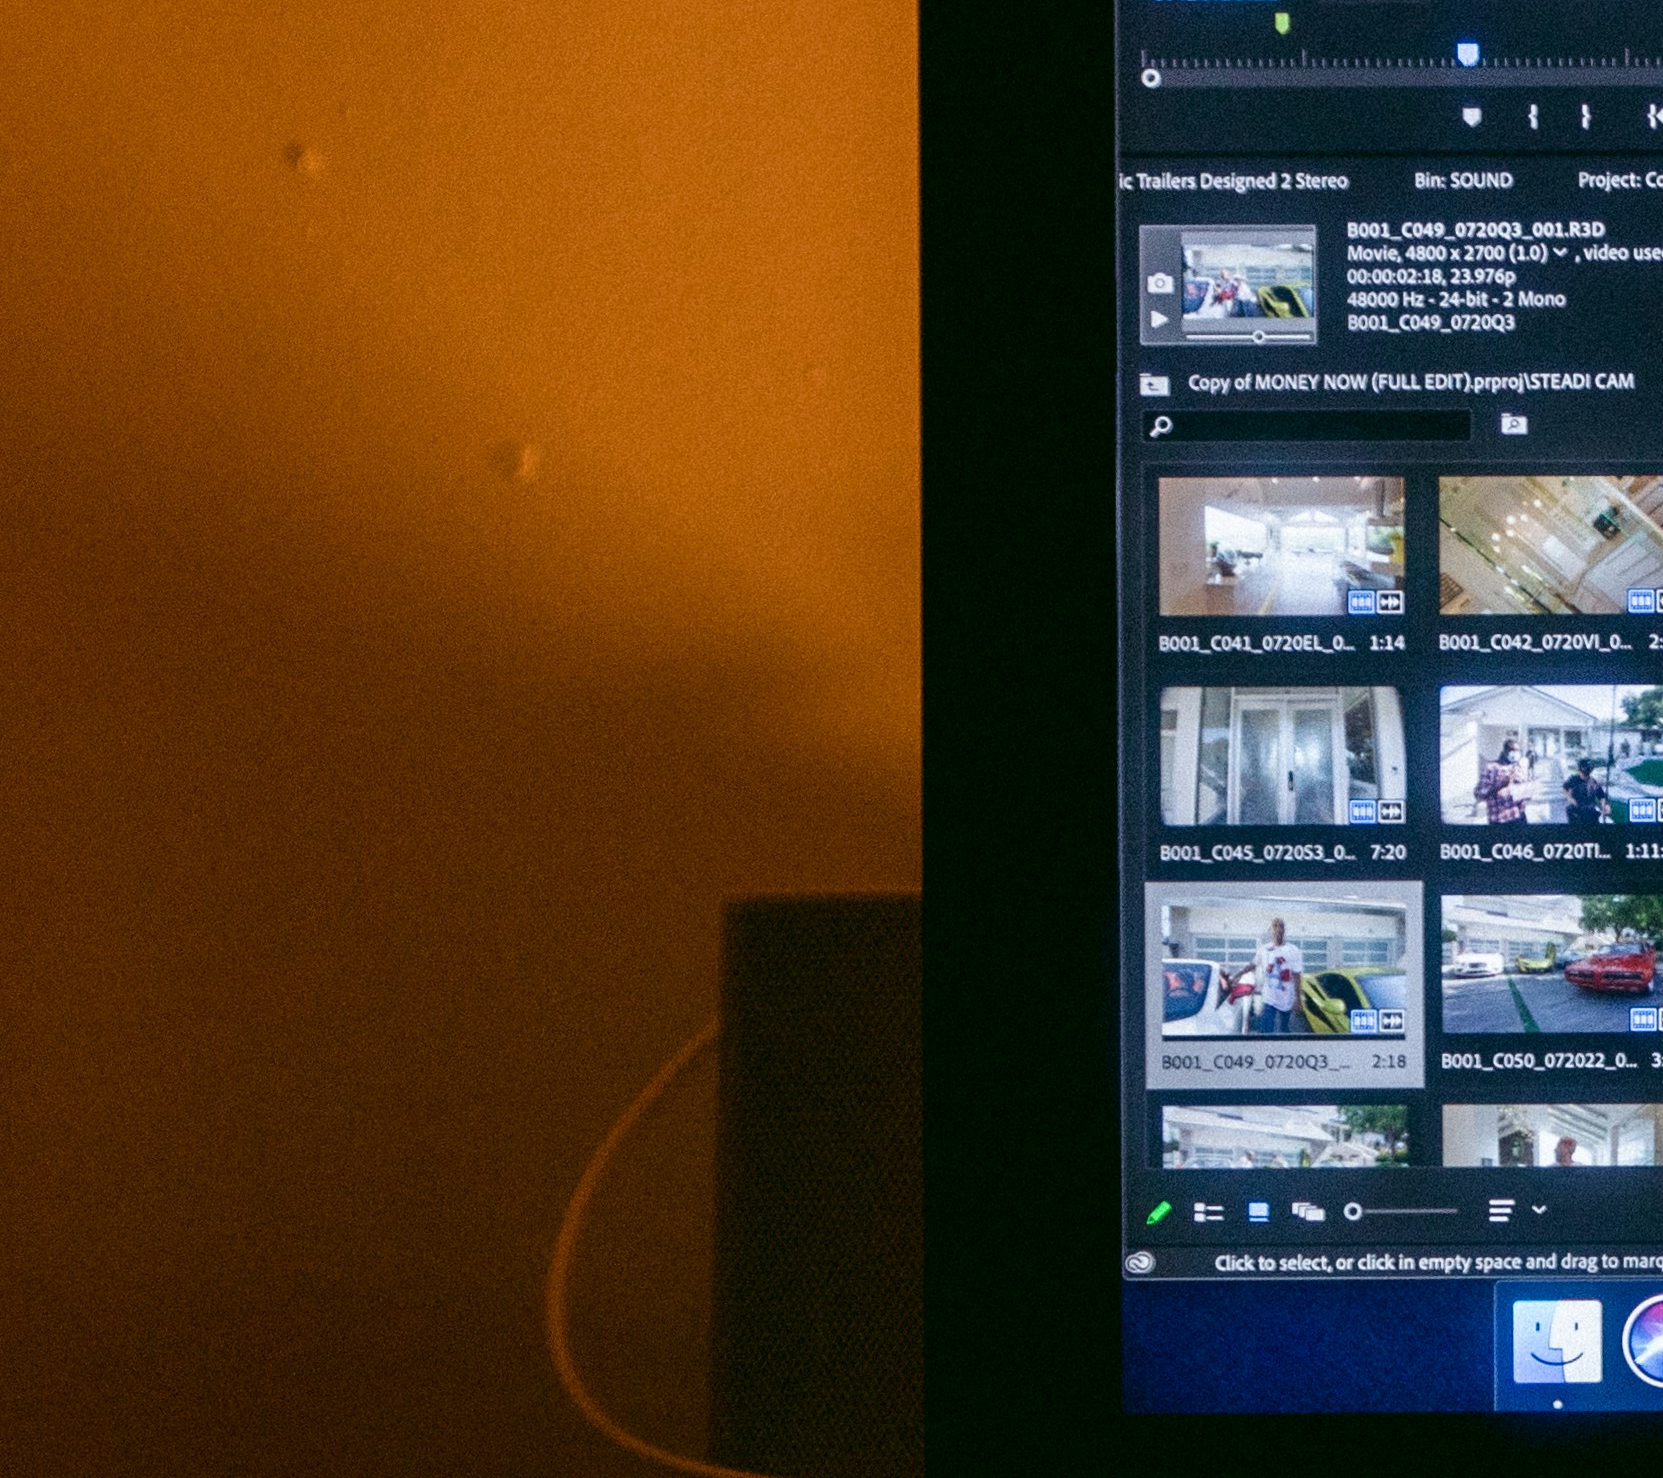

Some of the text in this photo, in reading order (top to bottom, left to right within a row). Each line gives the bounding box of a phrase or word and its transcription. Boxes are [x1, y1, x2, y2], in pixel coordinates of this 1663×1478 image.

[1136, 172, 1197, 190] Trailers
[1200, 171, 1278, 194] Designed
[1280, 172, 1292, 190] 2
[1295, 172, 1350, 190] Stereo
[1414, 171, 1514, 189] Bin: SOUND
[1578, 171, 1641, 192] Project:
[1347, 221, 1606, 241] B001_C049_0720Q3_001.R3D
[1347, 245, 1403, 264] Movie,
[1405, 244, 1448, 262] 4800
[1450, 248, 1461, 261] x
[1464, 244, 1506, 262] 2700
[1508, 242, 1549, 264] (1.0)
[1583, 243, 1630, 261] video
[1346, 267, 1517, 288] 00:00:02:18, 23.976p
[1347, 290, 1567, 308] 48000 Hz 24-bit 2 Mono
[1347, 313, 1516, 333] B001_C049_0720Q3
[1370, 634, 1406, 651] 1:14
[1372, 1053, 1408, 1069] 2:18
[1214, 1254, 1255, 1272] Click
[1257, 1255, 1277, 1272] to
[1279, 1253, 1333, 1273] select,
[1335, 1257, 1355, 1271] or
[1357, 1253, 1396, 1271] click
[1398, 1254, 1416, 1270] in
[1418, 1255, 1472, 1274] empty
[1475, 1256, 1523, 1274] space
[1525, 1252, 1557, 1270] and
[1560, 1252, 1599, 1274] drag
[1601, 1254, 1620, 1269] to
